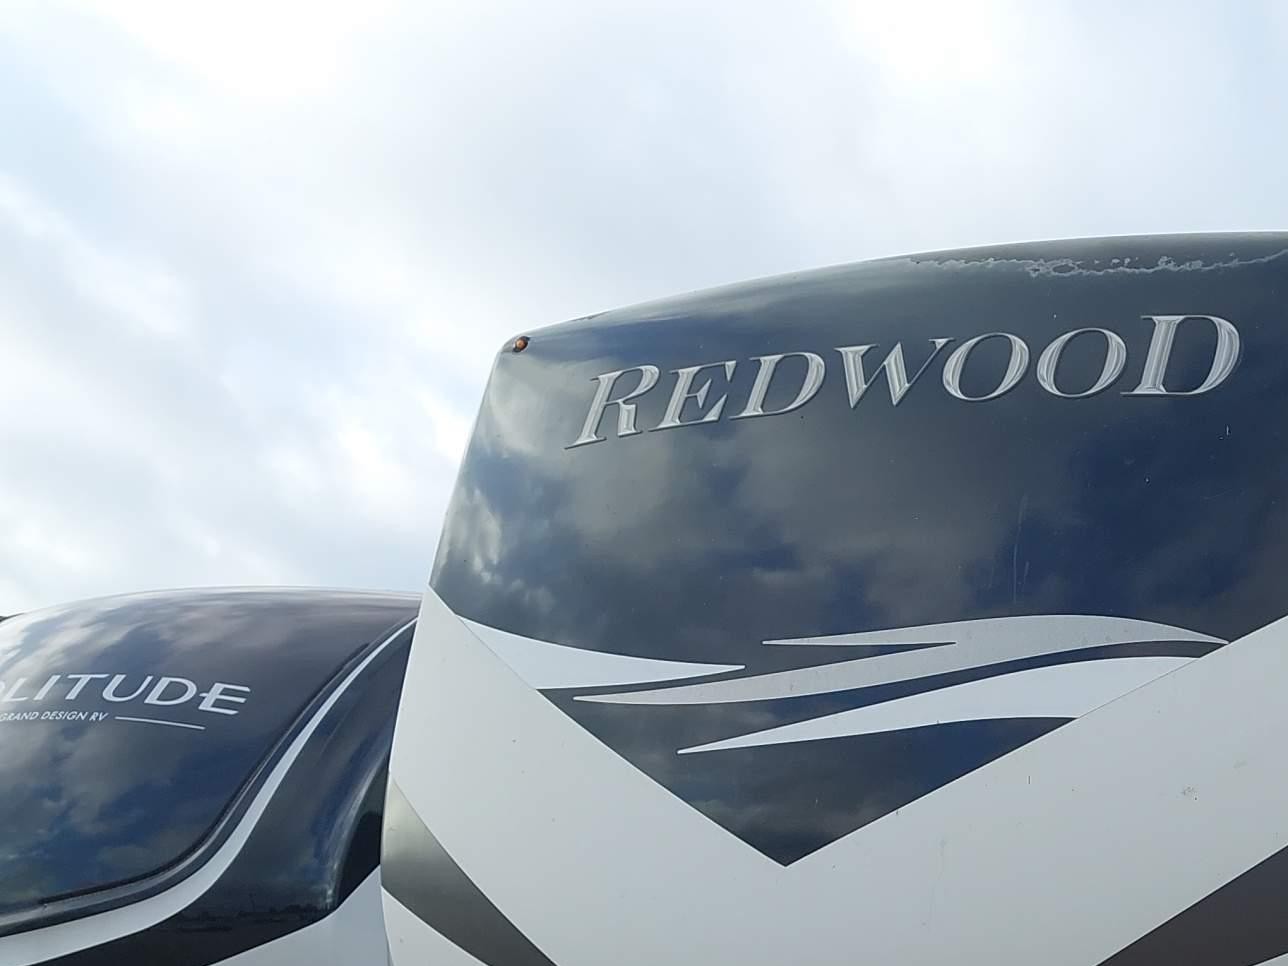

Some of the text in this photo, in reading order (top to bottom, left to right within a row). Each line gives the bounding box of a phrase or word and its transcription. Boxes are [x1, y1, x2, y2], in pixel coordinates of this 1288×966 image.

[563, 314, 1242, 450] REDWOOD
[0, 711, 110, 722] GRAND DESIGN RV
